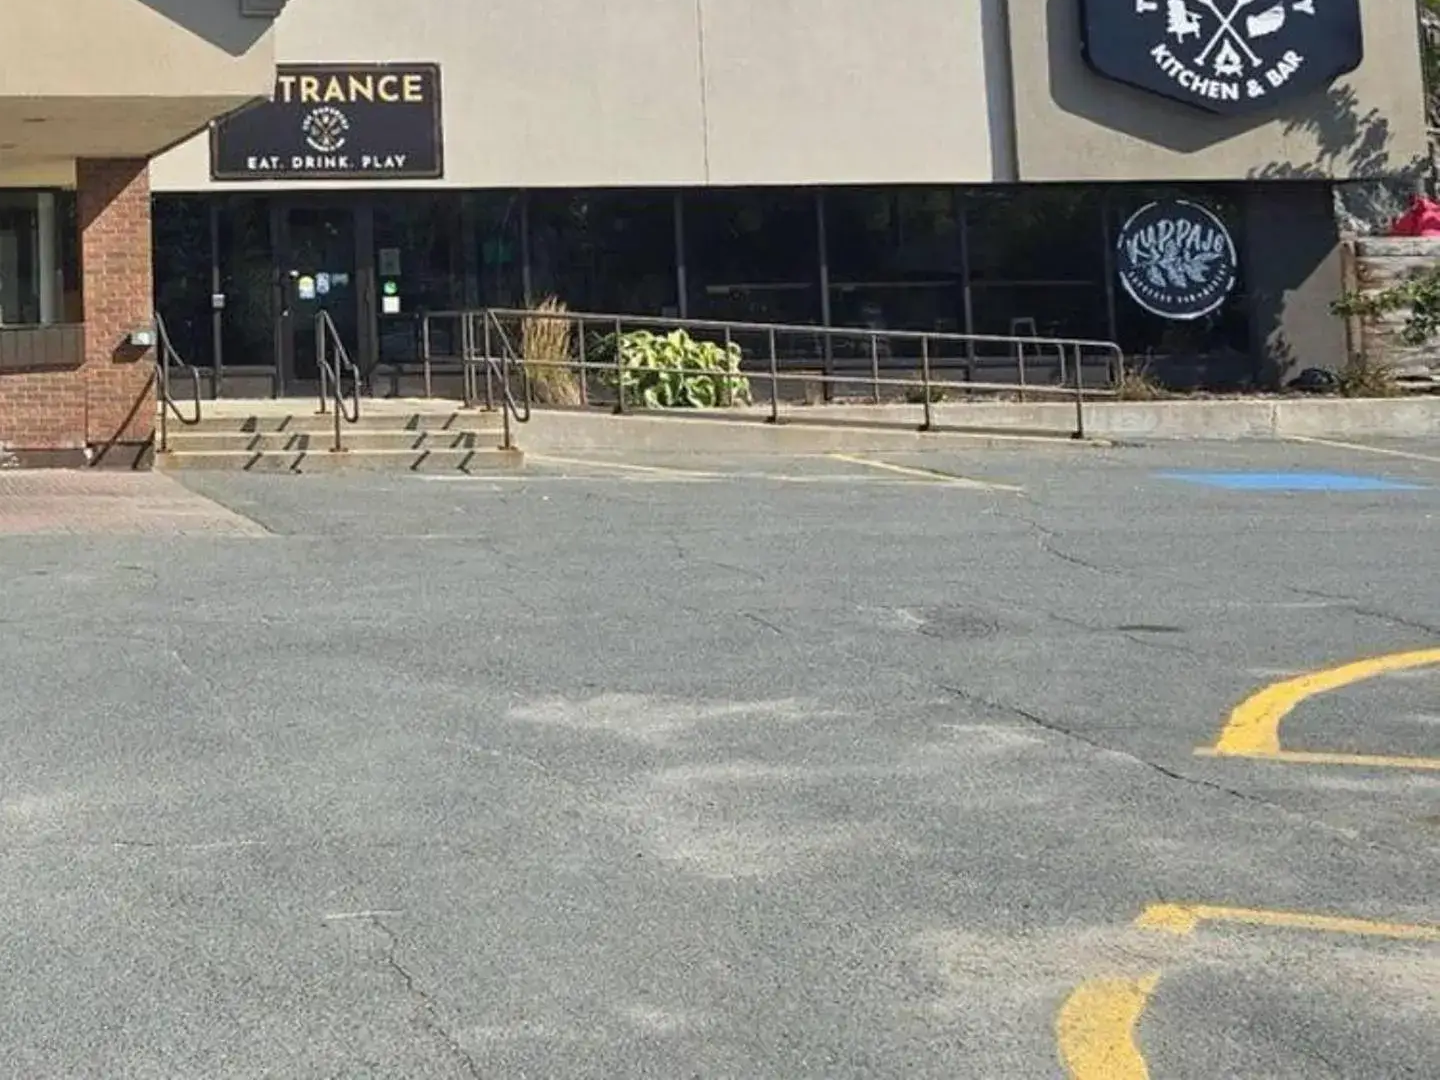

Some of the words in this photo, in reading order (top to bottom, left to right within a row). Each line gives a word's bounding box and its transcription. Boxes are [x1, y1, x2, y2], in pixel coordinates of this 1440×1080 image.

[1150, 43, 1239, 100] KITCHEN
[1246, 79, 1266, 98] &
[1265, 49, 1304, 87] BAR
[269, 75, 423, 103] TRANCE
[361, 154, 406, 169] PLAY
